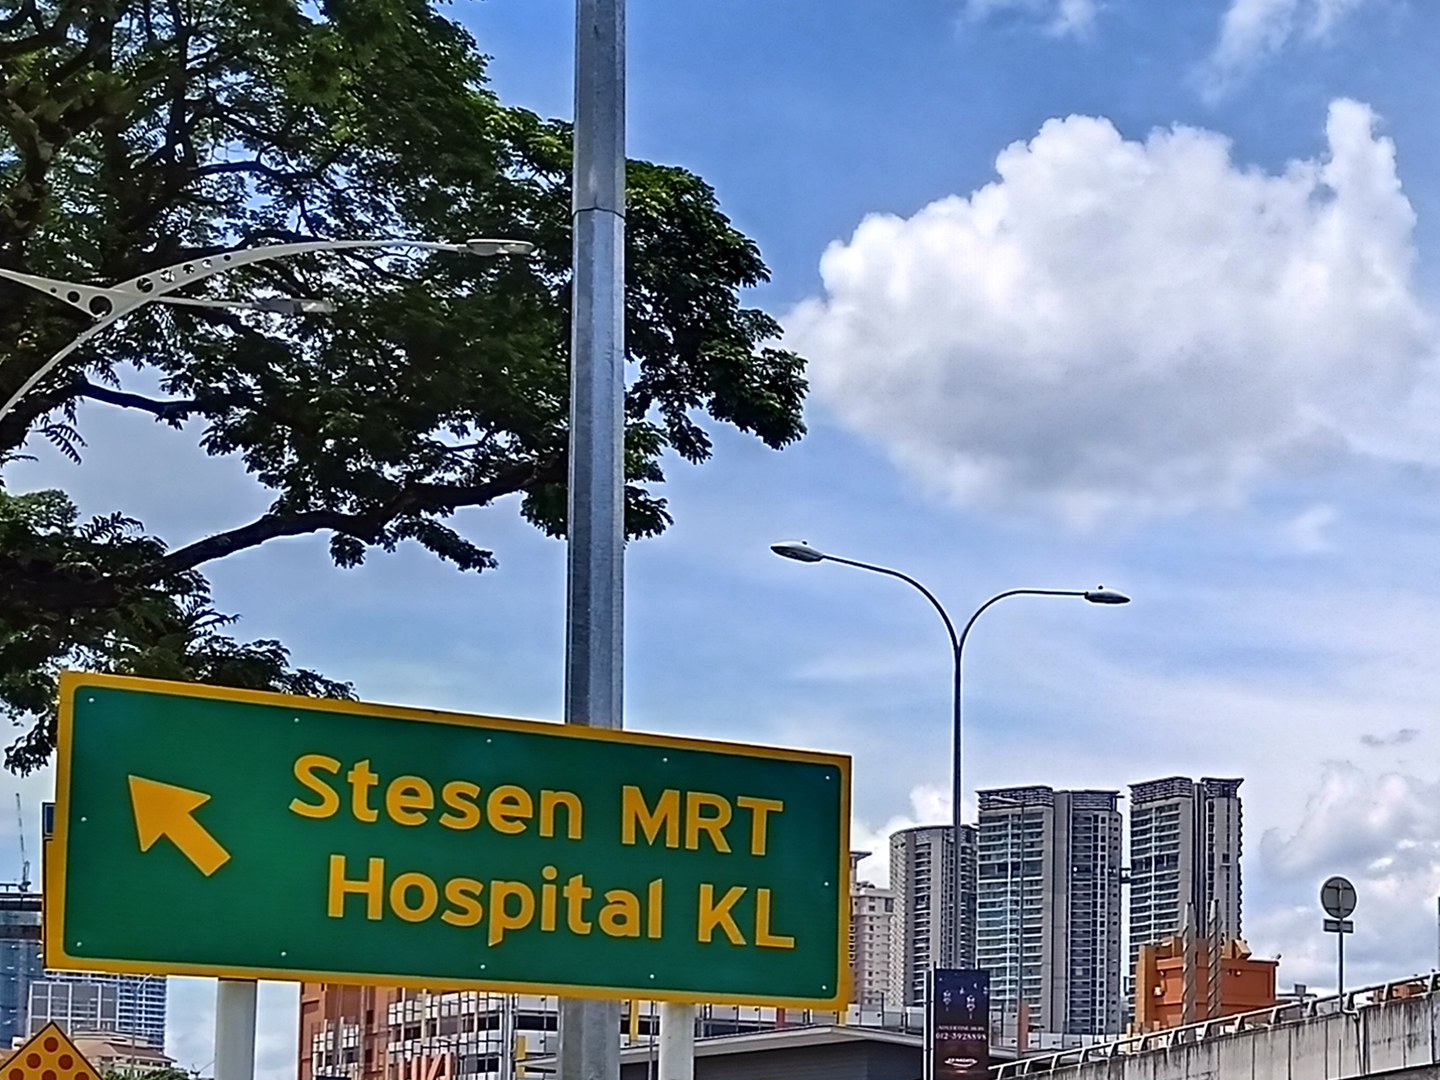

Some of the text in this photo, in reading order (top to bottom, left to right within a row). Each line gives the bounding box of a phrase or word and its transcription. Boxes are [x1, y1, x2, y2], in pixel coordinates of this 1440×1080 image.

[289, 754, 784, 856] Stesen MRT
[328, 854, 796, 949] Hospital KL
